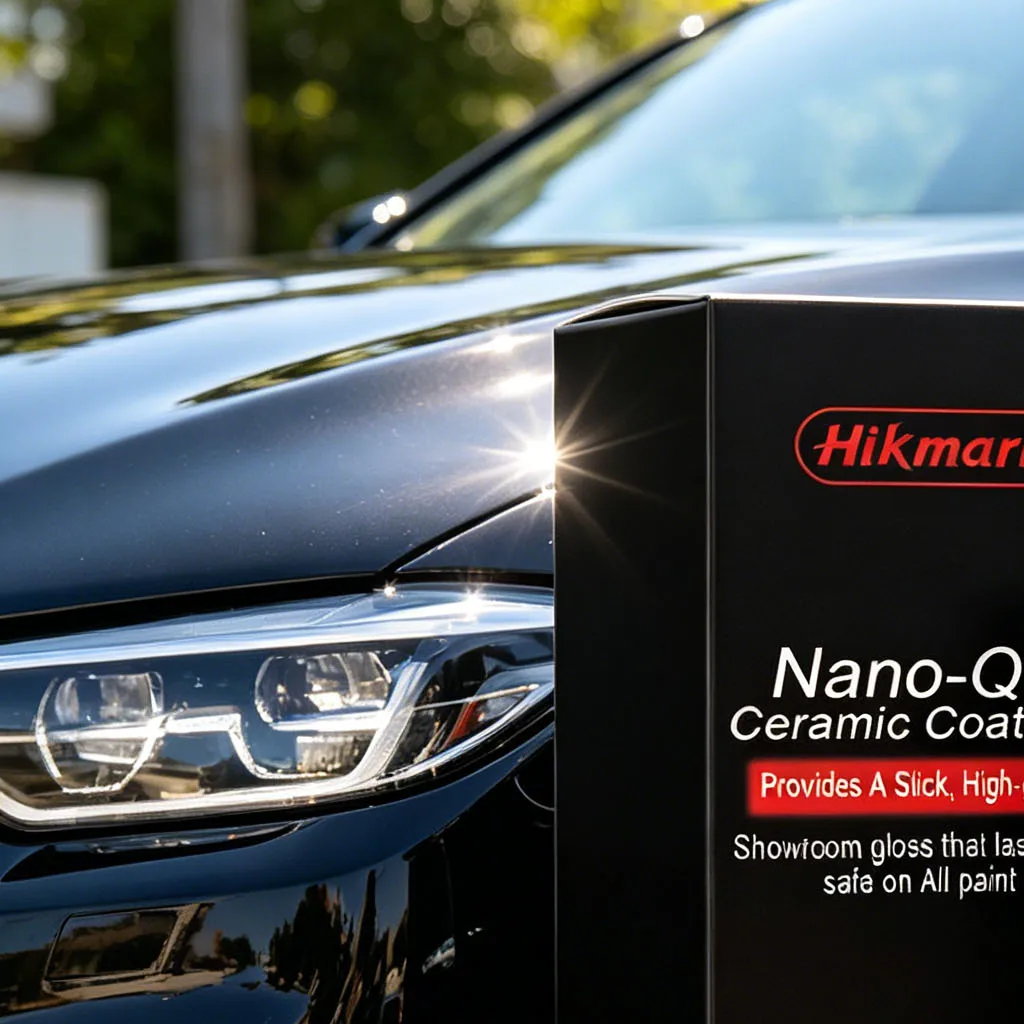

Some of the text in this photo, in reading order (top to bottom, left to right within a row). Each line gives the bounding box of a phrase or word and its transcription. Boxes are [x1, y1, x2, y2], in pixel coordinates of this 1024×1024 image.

[730, 705, 911, 741] Ceramic
[760, 770, 863, 798] Provides
[868, 771, 887, 798] A
[894, 769, 955, 803] Slick,
[733, 833, 863, 860] Showroom
[870, 832, 934, 867] gloss
[940, 830, 987, 858] that
[823, 867, 874, 895] safe
[882, 873, 912, 894] on
[920, 865, 949, 893] All
[959, 865, 1017, 900] paint
